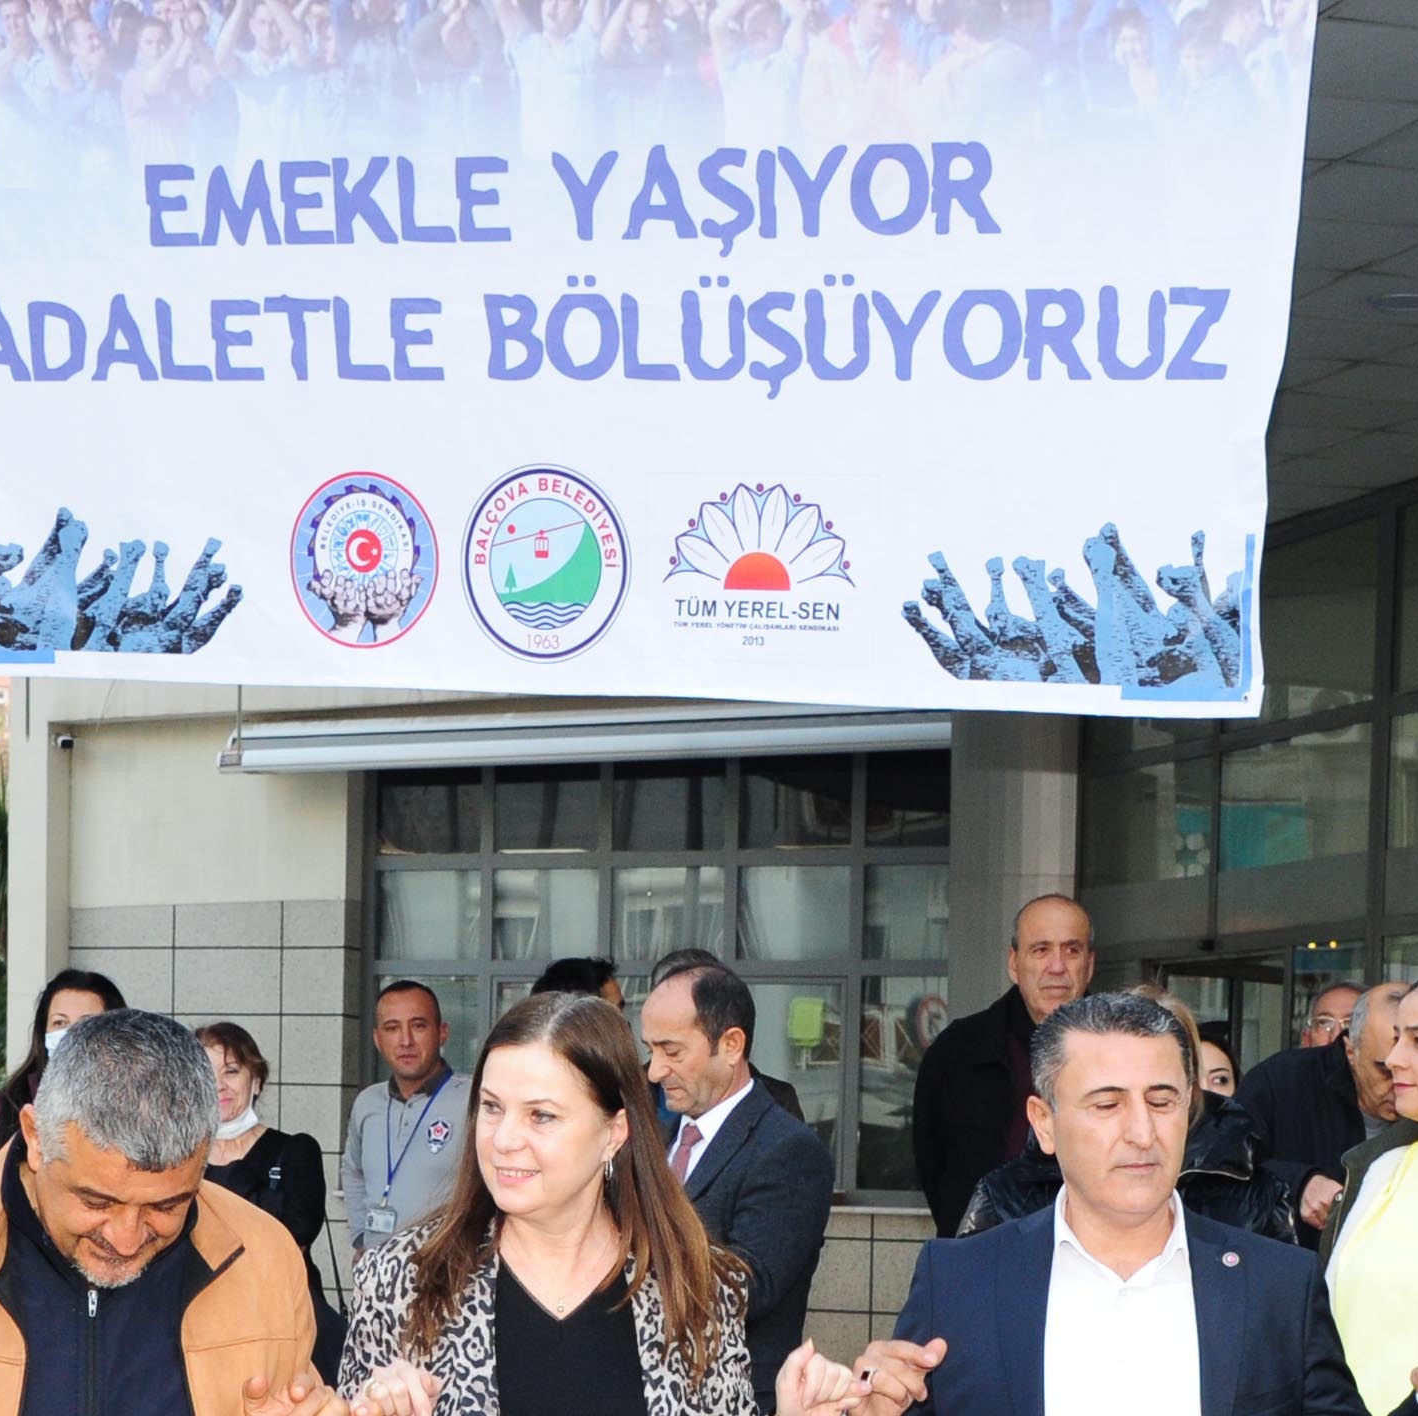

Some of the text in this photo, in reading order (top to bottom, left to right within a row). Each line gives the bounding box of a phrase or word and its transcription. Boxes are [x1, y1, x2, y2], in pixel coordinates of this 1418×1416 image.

[145, 141, 1002, 257] EMEKLE YAŞIYOR
[483, 273, 1231, 400] BÖLÜŞÜYORUZ
[474, 477, 621, 568] BALÇOVA BELEDİYESİ
[675, 595, 840, 621] TÜM YEREL-SEN
[527, 634, 560, 650] 1963
[742, 635, 765, 647] 2013
